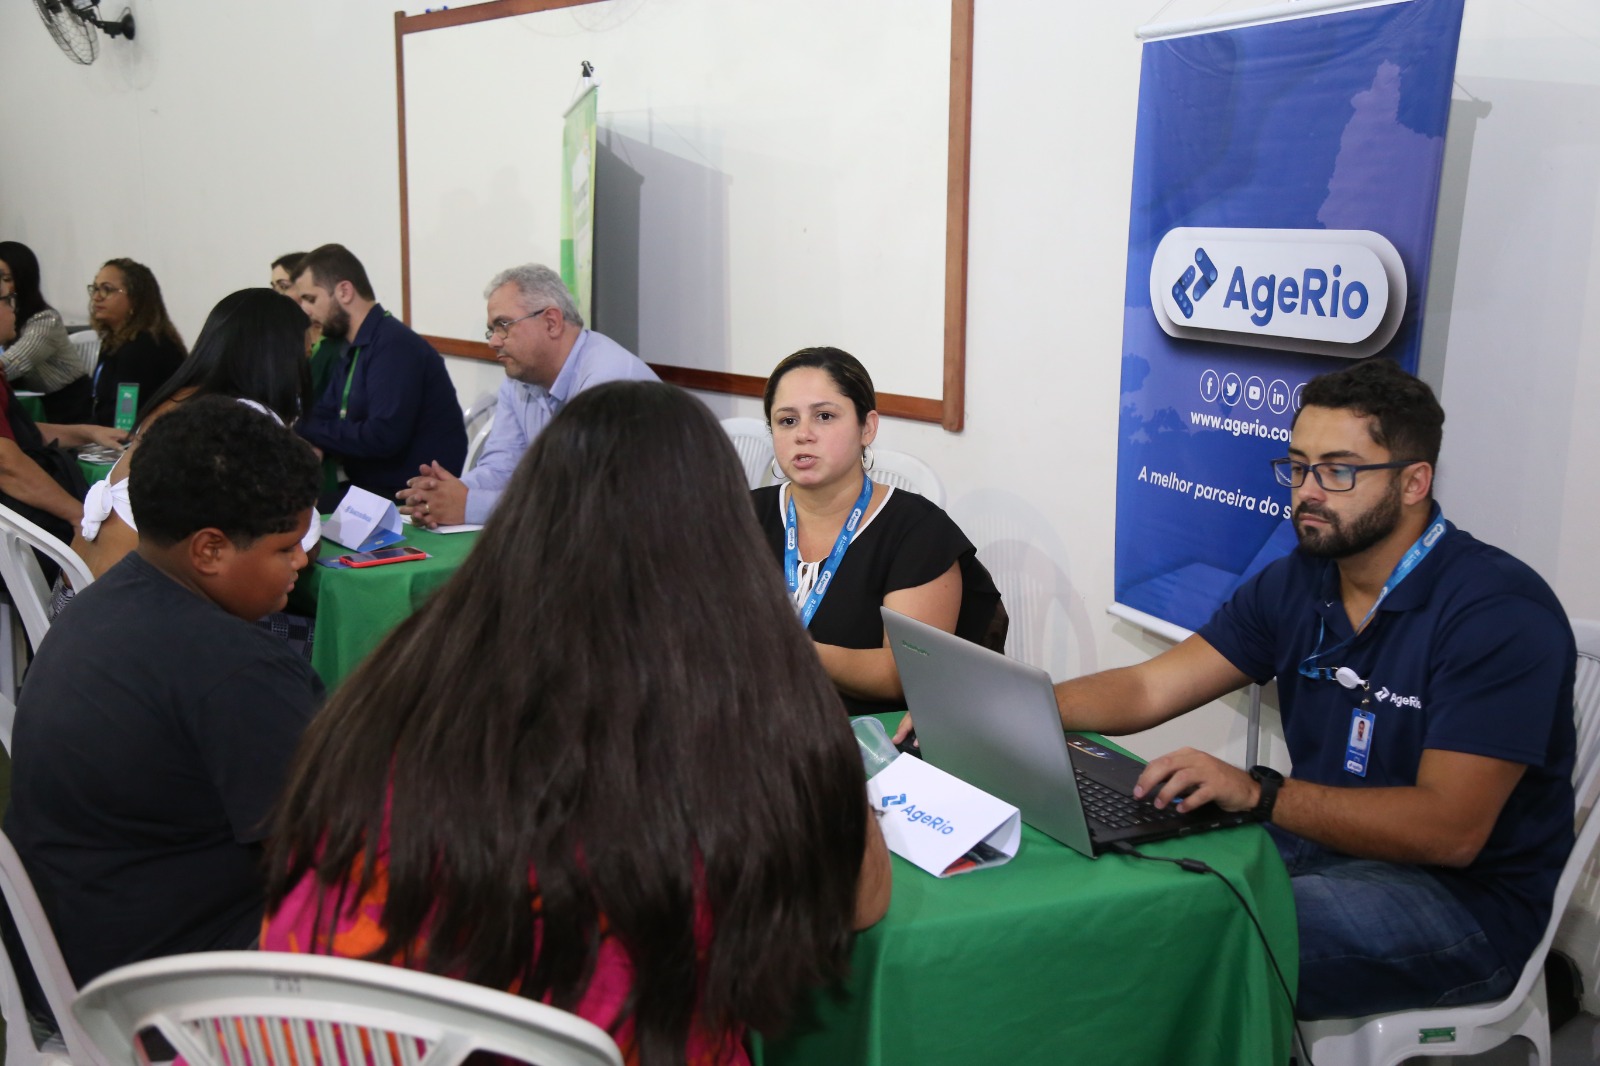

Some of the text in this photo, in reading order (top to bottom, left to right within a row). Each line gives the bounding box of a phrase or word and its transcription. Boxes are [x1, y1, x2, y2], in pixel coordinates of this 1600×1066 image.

[1223, 264, 1369, 327] AgeRio
[1138, 465, 1147, 482] A
[1150, 471, 1193, 494] melhor
[1194, 483, 1256, 511] parceira
[1258, 496, 1280, 517] do
[900, 804, 954, 836] AgeRio
